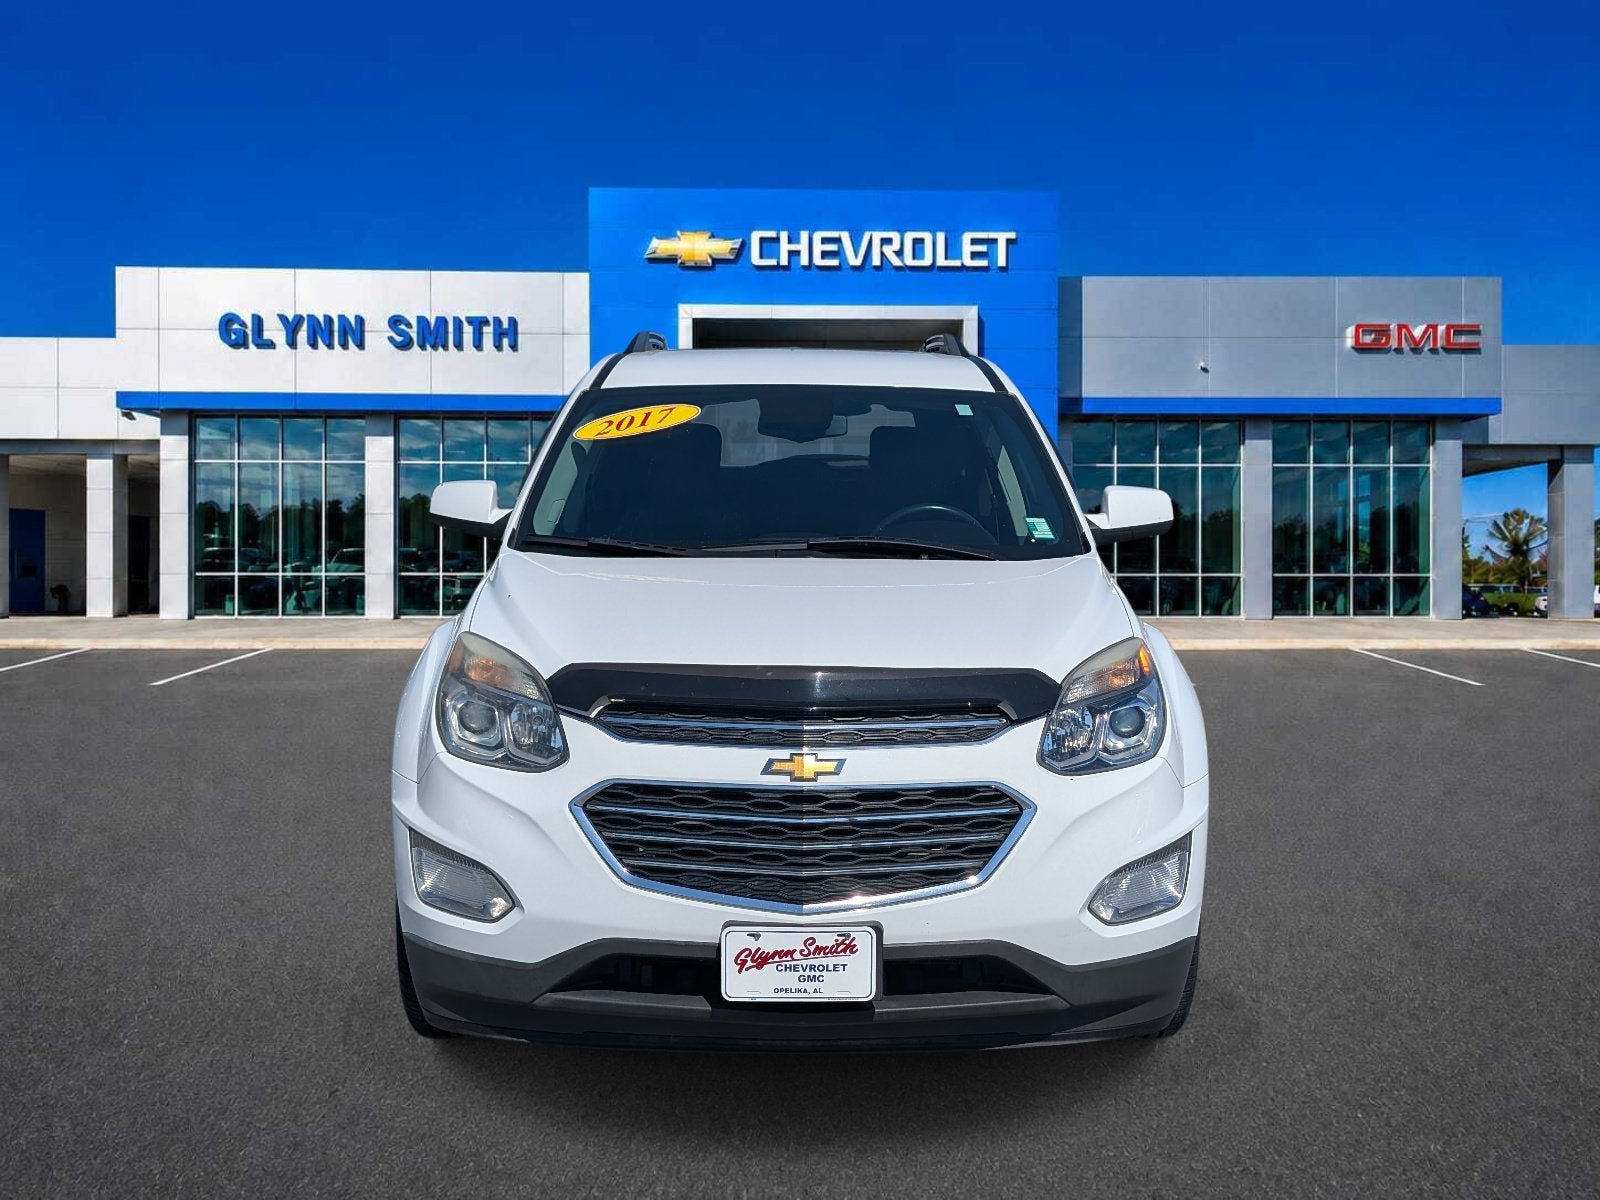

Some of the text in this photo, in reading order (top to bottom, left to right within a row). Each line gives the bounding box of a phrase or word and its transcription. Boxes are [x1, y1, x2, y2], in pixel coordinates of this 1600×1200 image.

[750, 230, 1017, 269] CHEVROLET
[218, 312, 519, 352] GLYNN SMITH
[1348, 323, 1482, 353] GMC
[593, 407, 676, 437] 2017
[733, 937, 859, 974] Glynn Smith
[775, 963, 848, 973] CHEVROLET
[773, 987, 812, 995] OPELIKA,
[797, 974, 825, 983] GMC
